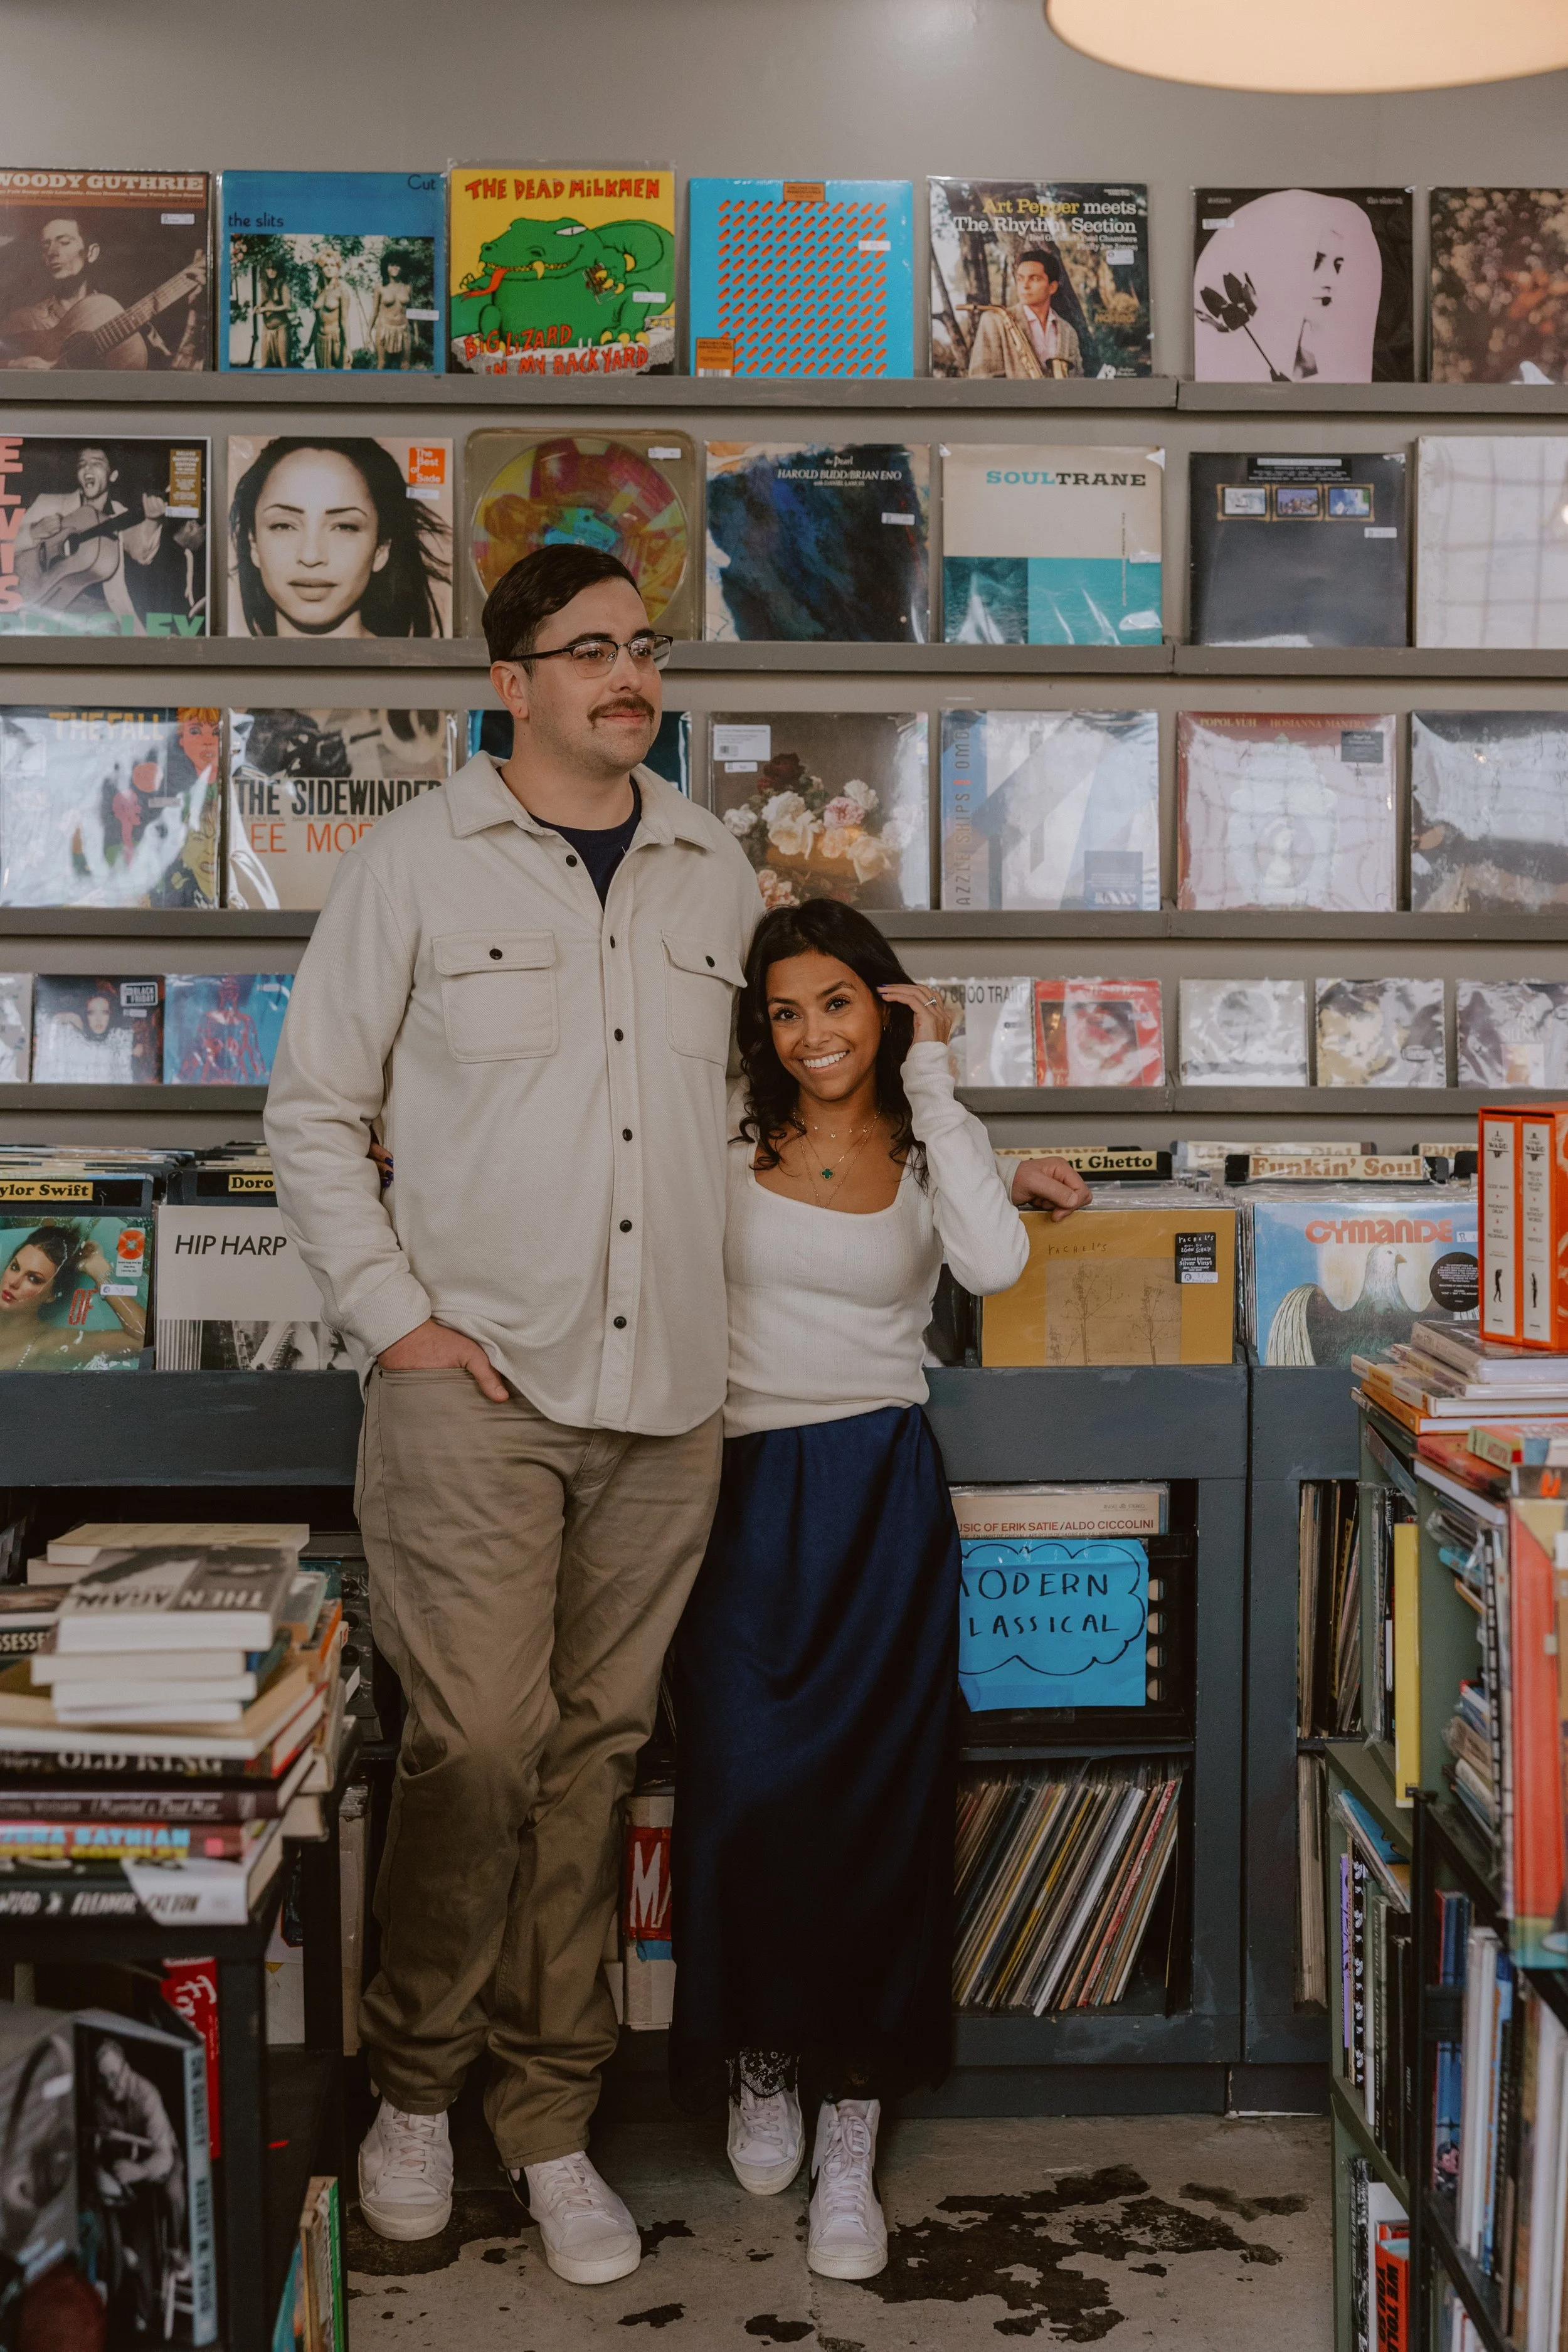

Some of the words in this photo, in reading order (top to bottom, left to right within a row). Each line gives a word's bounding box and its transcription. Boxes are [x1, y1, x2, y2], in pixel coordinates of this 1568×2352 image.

[87, 175, 204, 191] GUTHRIE
[408, 174, 436, 190] Cut
[465, 178, 507, 200] THE
[514, 178, 564, 200] DEAD
[982, 198, 1013, 214] Art
[1017, 198, 1079, 217] Pepper
[1083, 200, 1136, 215] meets
[228, 209, 250, 227] the
[256, 208, 283, 227] slits
[953, 216, 989, 232] The
[993, 217, 1066, 236] Rhythm
[1071, 217, 1136, 233] Section
[519, 354, 546, 376] MY
[416, 448, 433, 458] The
[777, 469, 818, 479] HAROLD
[881, 470, 902, 480] ENO
[986, 471, 1147, 486] SOULTRANE
[50, 712, 104, 741] THE
[106, 712, 165, 741] FALL
[235, 780, 280, 815] THE
[1088, 1155, 1153, 1169] Ghetto
[1252, 1157, 1356, 1176] Funkin'
[1364, 1157, 1422, 1177] Soul
[39, 1183, 89, 1197] Swift
[175, 1234, 216, 1255] HIP
[221, 1235, 287, 1256] HARP
[68, 1288, 98, 1325] OF
[984, 1522, 999, 1532] OF
[1003, 1522, 1027, 1532] ERIK
[1098, 1519, 1154, 1530] CICCOLINI
[1387, 2263, 1399, 2301] WE
